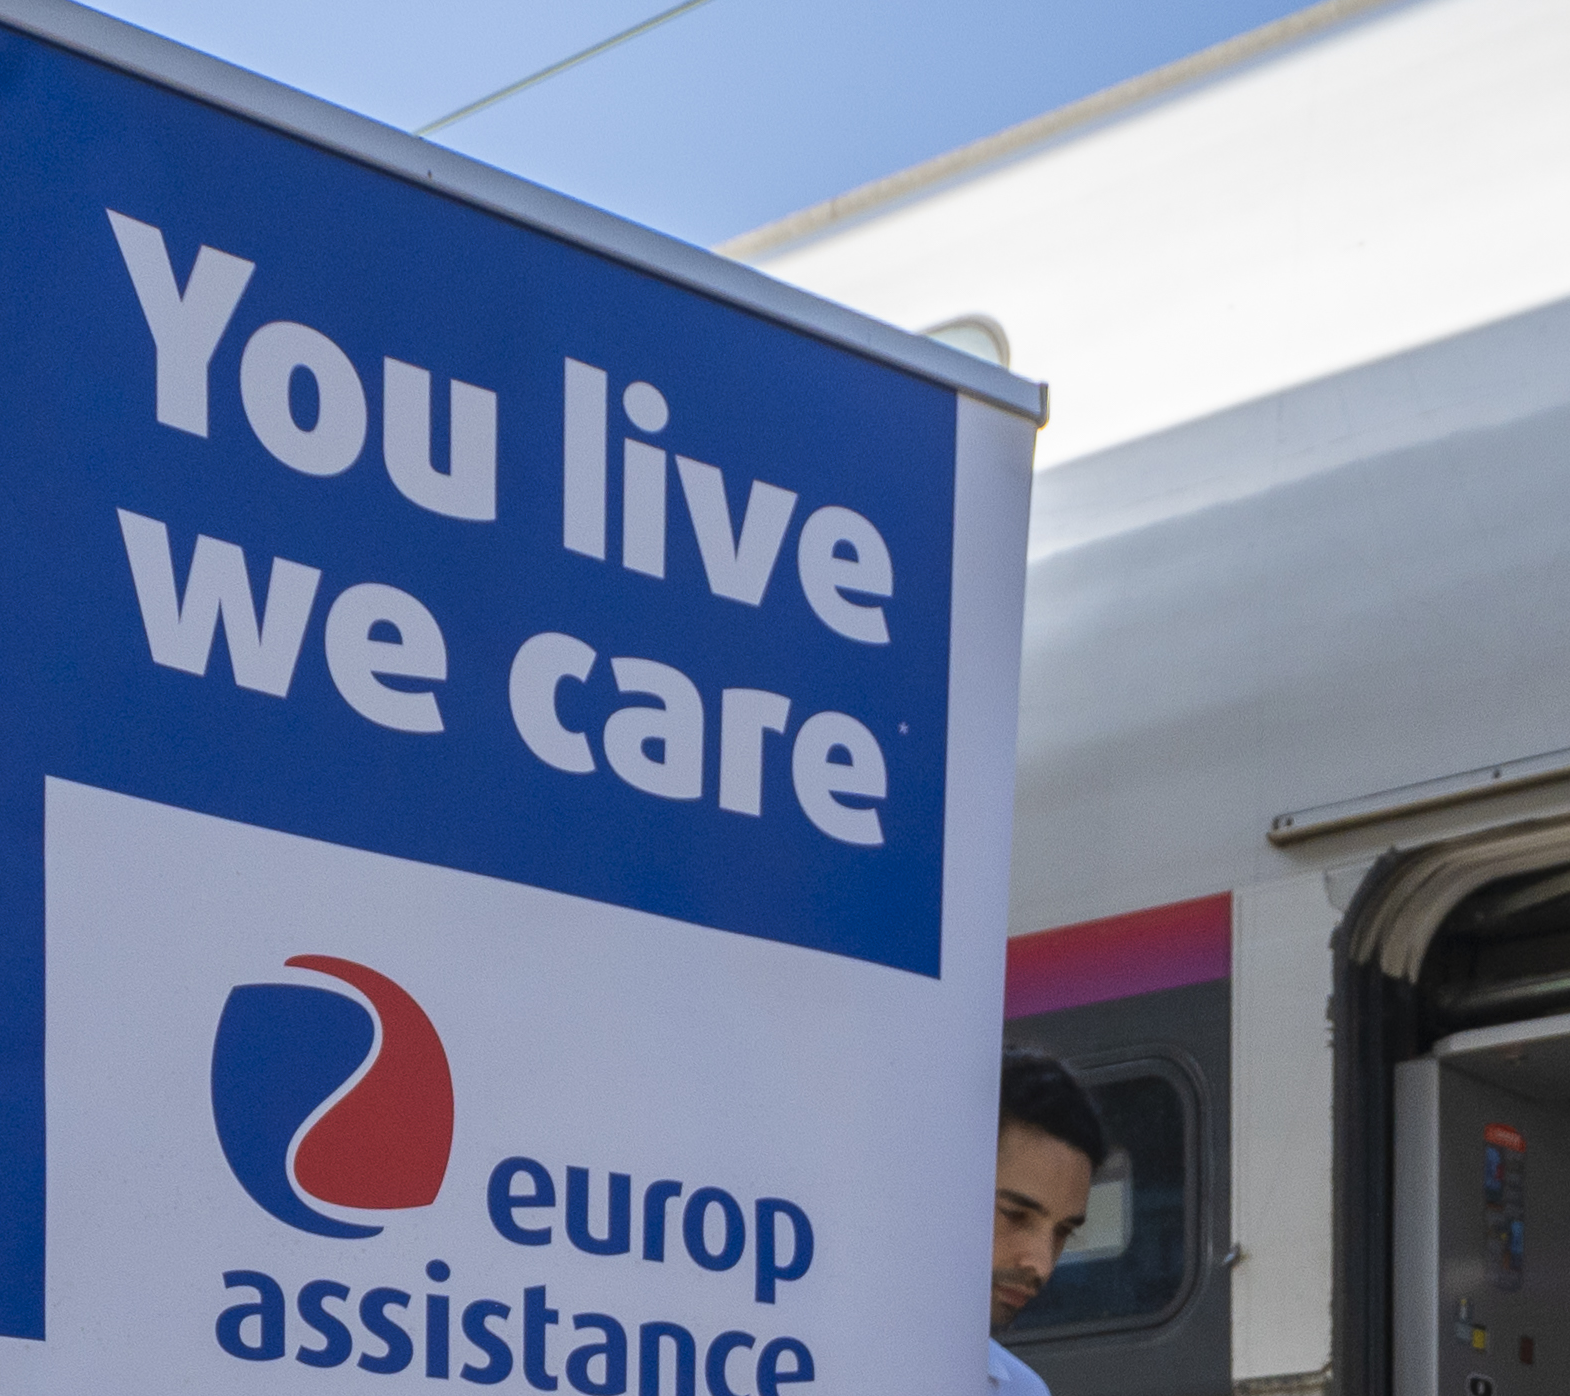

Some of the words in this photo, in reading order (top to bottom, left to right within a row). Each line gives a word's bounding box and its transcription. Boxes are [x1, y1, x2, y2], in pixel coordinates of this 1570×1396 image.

[104, 208, 499, 523] You
[561, 354, 896, 646] live
[116, 507, 448, 734] we
[508, 631, 888, 846] care
[485, 1153, 815, 1306] europ
